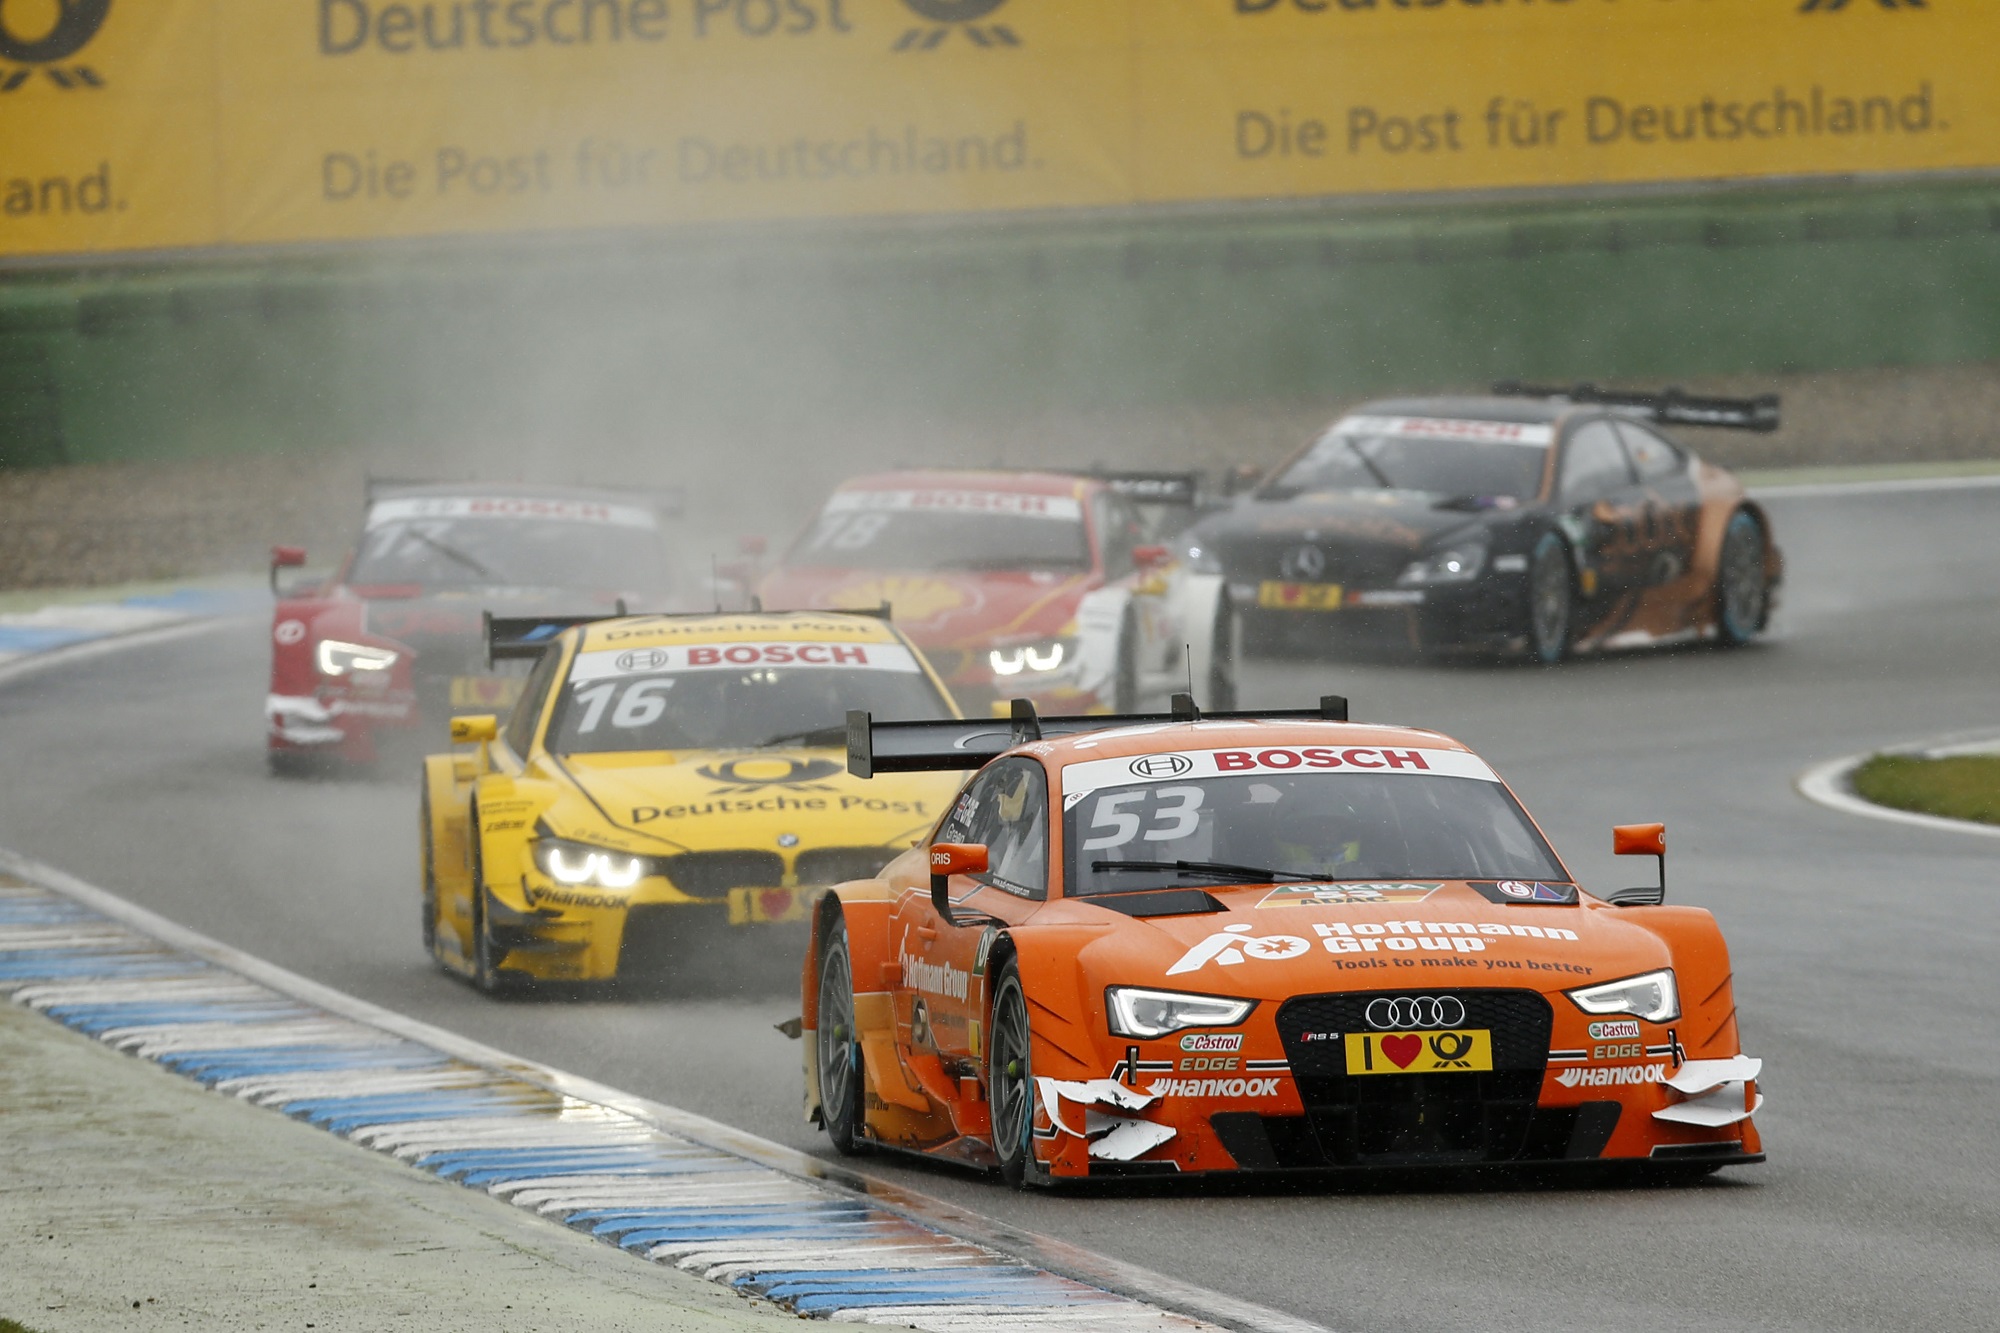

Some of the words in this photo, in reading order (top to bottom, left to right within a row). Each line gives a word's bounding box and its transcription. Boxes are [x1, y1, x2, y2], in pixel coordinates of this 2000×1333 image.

[318, 0, 669, 56] Deutsche
[690, 0, 854, 39] Post
[1236, 107, 1327, 159] Die
[1348, 105, 1463, 155] Post
[1484, 95, 1566, 148] für
[1585, 78, 1950, 144] Deutschland.
[322, 149, 417, 201] Die
[437, 145, 553, 195] Post
[575, 135, 656, 188] für
[677, 119, 1045, 183] Deutschland.
[605, 622, 780, 641] Deutsche
[687, 645, 869, 666] BOSCH
[574, 678, 676, 734] 16
[1213, 749, 1431, 772] BOSCH
[632, 795, 827, 824] Deutsche
[839, 795, 929, 816] Post
[1082, 786, 1205, 850] 53
[931, 852, 951, 865] ORIS
[1288, 883, 1427, 892] DEKRA
[1311, 920, 1579, 941] Hoffmann
[1332, 957, 1387, 970] Tools
[1393, 957, 1415, 967] to
[1420, 956, 1477, 968] make
[1484, 958, 1522, 970] you
[1528, 959, 1593, 976] better
[909, 953, 943, 995] Hoffmann
[944, 961, 968, 1004] Group
[1602, 1023, 1638, 1037] Castrol
[1194, 1035, 1240, 1050] Castrol
[1363, 1036, 1373, 1070] I
[1593, 1043, 1642, 1059] EDGE
[1179, 1057, 1240, 1071] EDGE
